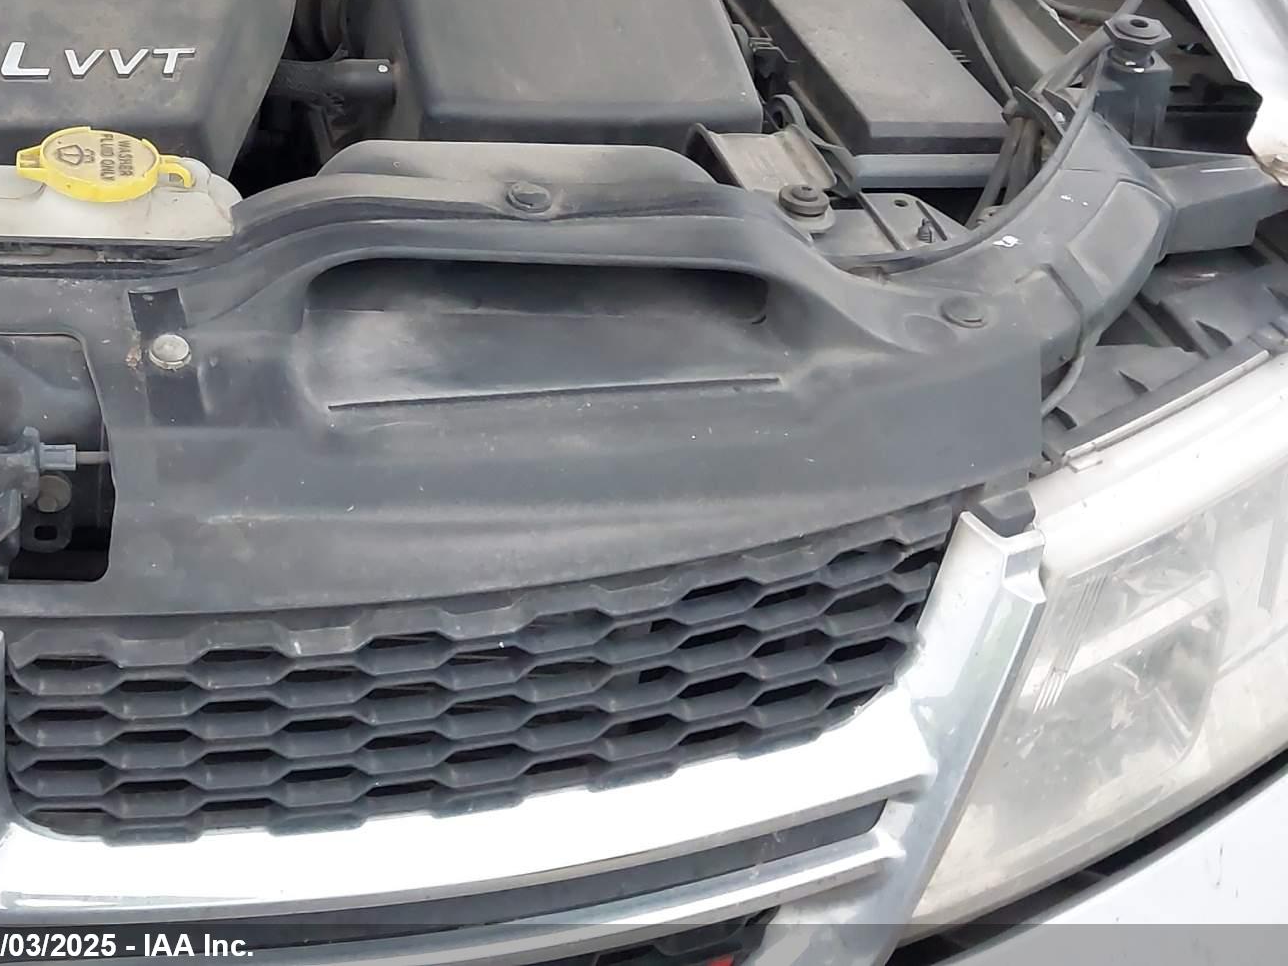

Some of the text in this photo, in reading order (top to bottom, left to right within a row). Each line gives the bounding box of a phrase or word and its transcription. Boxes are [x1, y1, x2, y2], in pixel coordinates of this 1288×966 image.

[64, 47, 197, 79] VVT
[100, 133, 115, 181] FLUID ONLY
[118, 140, 135, 177] WASHER
